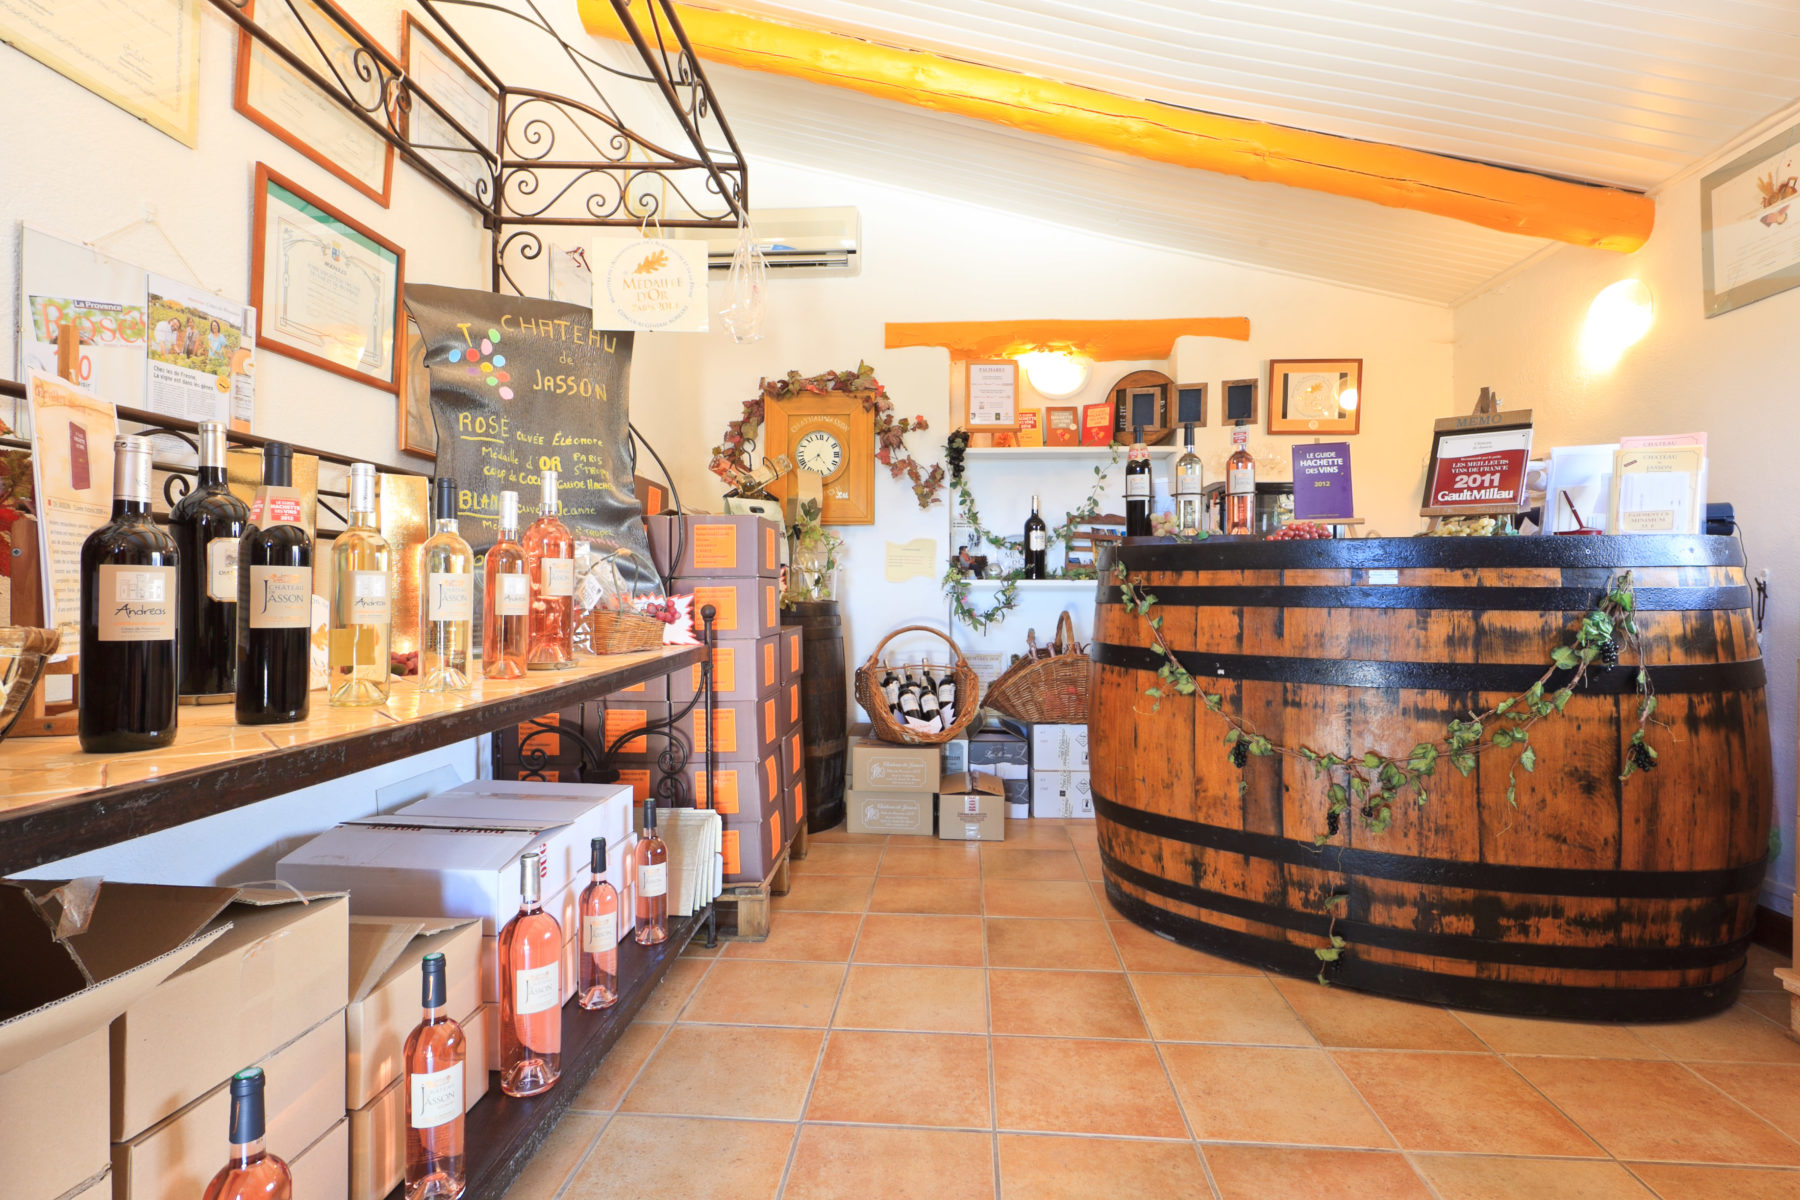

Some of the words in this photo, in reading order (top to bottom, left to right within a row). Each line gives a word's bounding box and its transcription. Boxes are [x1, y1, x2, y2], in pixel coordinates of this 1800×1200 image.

[85, 301, 122, 312] Provence
[559, 351, 574, 365] de
[533, 369, 607, 401] JASSON
[1456, 414, 1502, 428] MEMO
[1300, 458, 1343, 467] HACHETTE
[1453, 473, 1501, 489] 2011
[459, 490, 501, 511] BLAN
[1438, 487, 1514, 502] GaultMillau
[261, 579, 304, 614] JASSON
